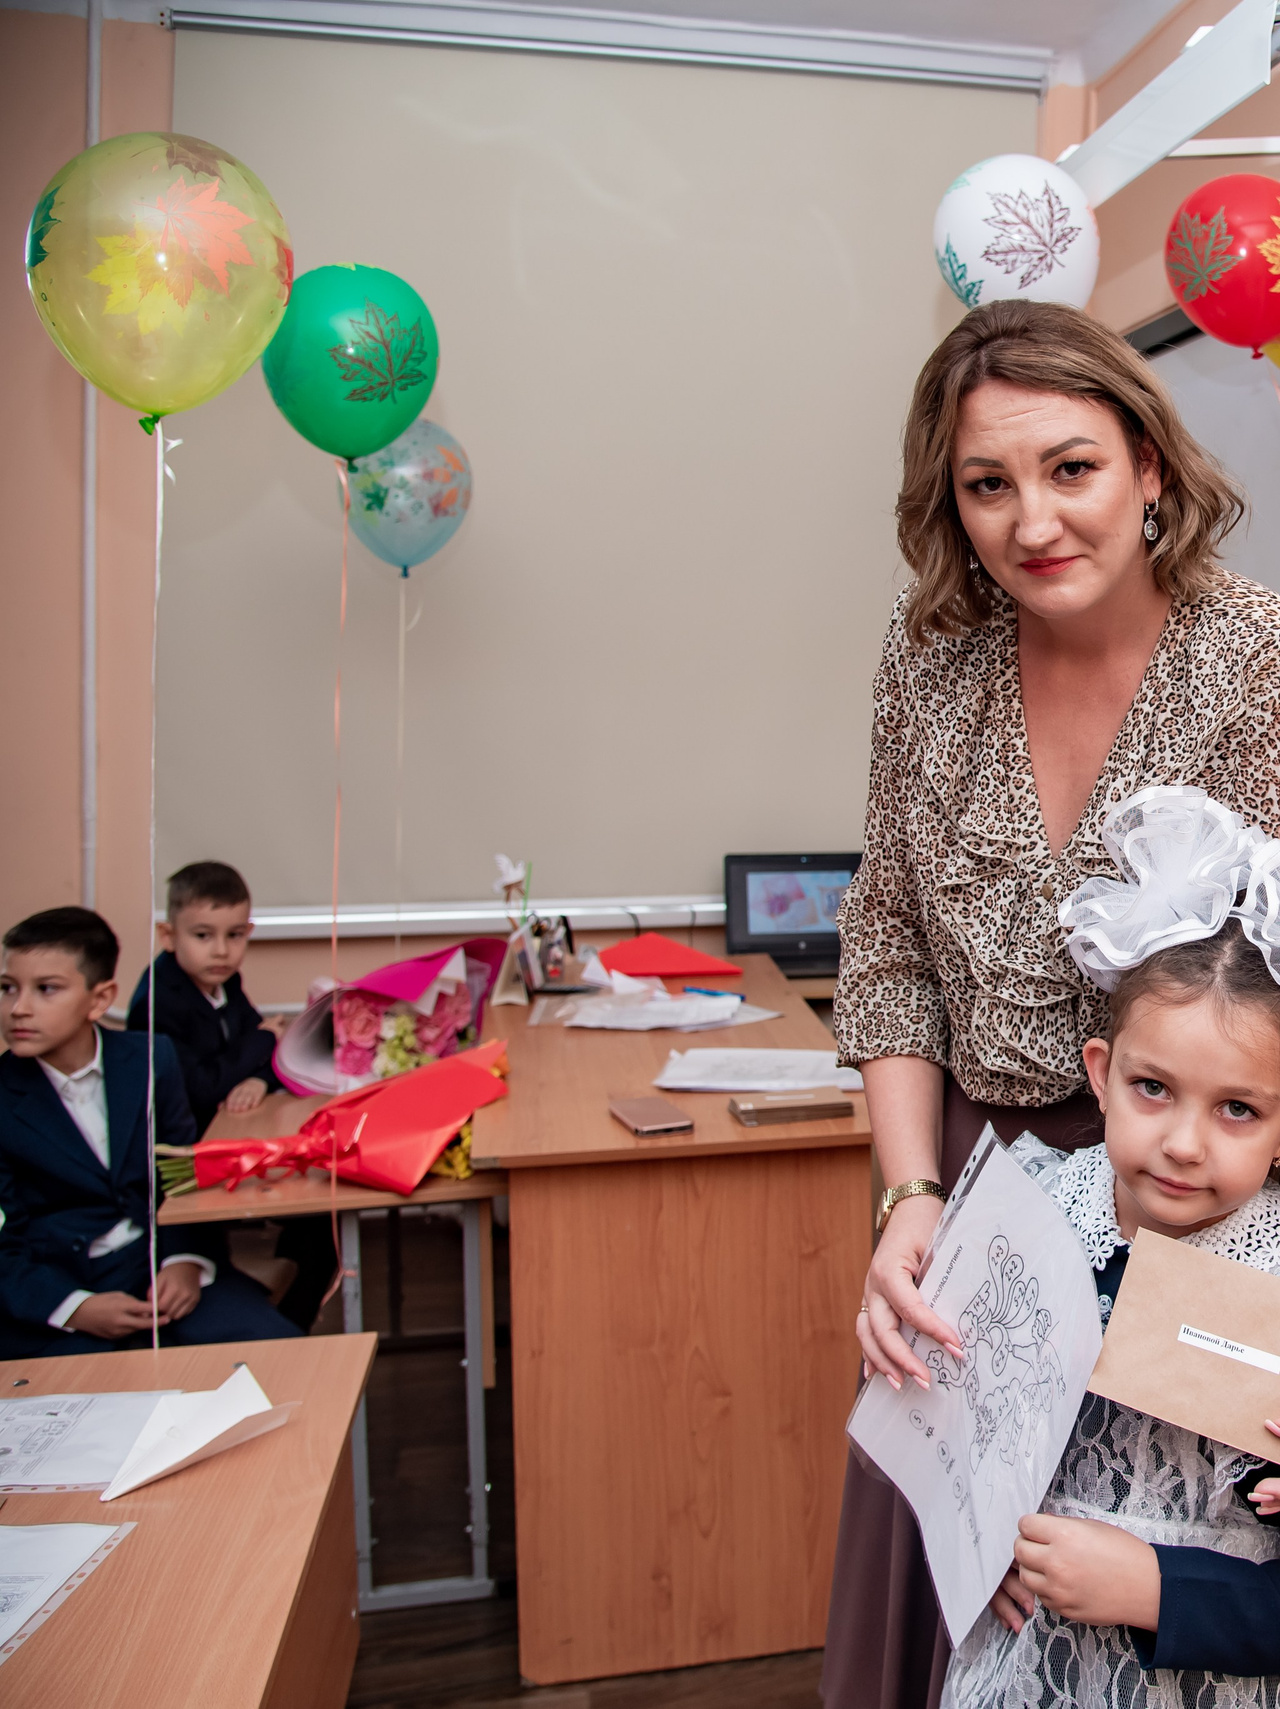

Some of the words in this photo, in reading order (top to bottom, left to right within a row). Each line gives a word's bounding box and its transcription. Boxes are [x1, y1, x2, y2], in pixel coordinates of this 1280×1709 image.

[932, 1275, 949, 1304] РАСКРАСЬ
[947, 1244, 963, 1275] КАРТИНКУ
[1182, 1326, 1220, 1346] Ивановой
[1221, 1340, 1245, 1354] Дарье
